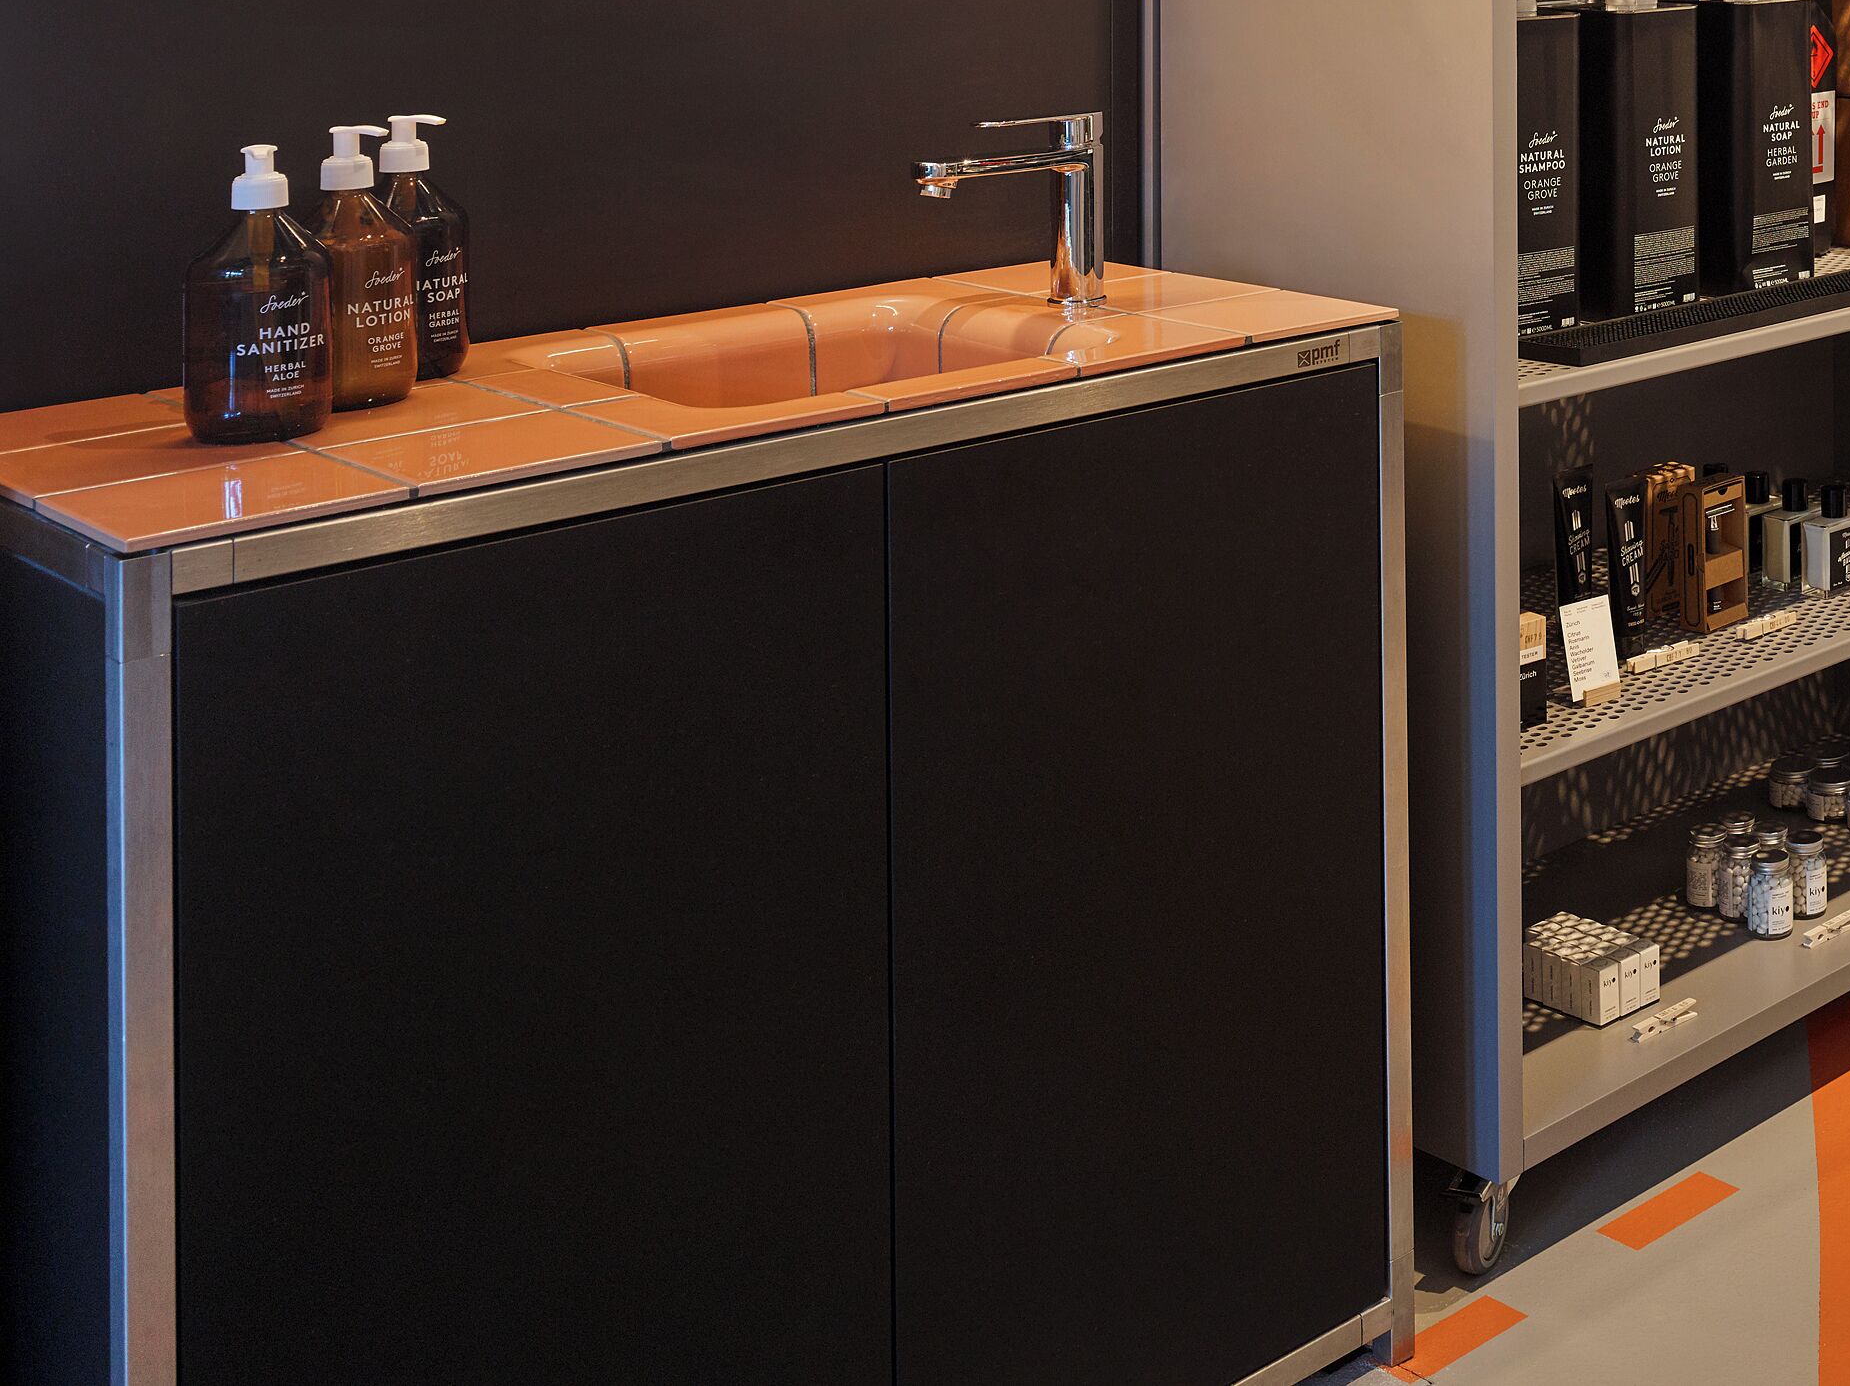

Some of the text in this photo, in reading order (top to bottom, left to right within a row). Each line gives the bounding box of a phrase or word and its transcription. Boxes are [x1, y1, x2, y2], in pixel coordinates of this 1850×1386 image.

[1819, 101, 1829, 109] END
[1763, 121, 1800, 133] NATURAL
[1646, 134, 1685, 147] NATURAL
[1771, 131, 1793, 142] SOAP
[1520, 150, 1564, 163] NATURAL
[1650, 145, 1682, 157] LOTION
[1767, 146, 1796, 157] HERBAL
[1519, 160, 1566, 174] SHAMPOO
[1649, 160, 1682, 172] ORANGE
[1766, 156, 1798, 167] GARDEN
[1652, 170, 1679, 183] GROVE
[1524, 177, 1561, 190] ORANGE
[1528, 188, 1558, 201] GROVE
[417, 273, 468, 291] ATURAL
[428, 288, 460, 303] SOAP
[347, 294, 414, 315] NATURAL
[356, 308, 411, 328] LOTION
[429, 309, 459, 320] HERBAL
[429, 317, 460, 329] GARDEN
[259, 322, 311, 340] HAND
[368, 332, 404, 345] ORANGE
[236, 334, 325, 357] SANITIZER
[372, 341, 401, 353] GROVE
[264, 361, 306, 374] HERBAL
[272, 371, 300, 381] ALOE
[1569, 537, 1591, 555] CREAM
[1621, 540, 1644, 557] Shaving
[1622, 548, 1644, 567] CREAM
[1566, 620, 1580, 628] Zürich
